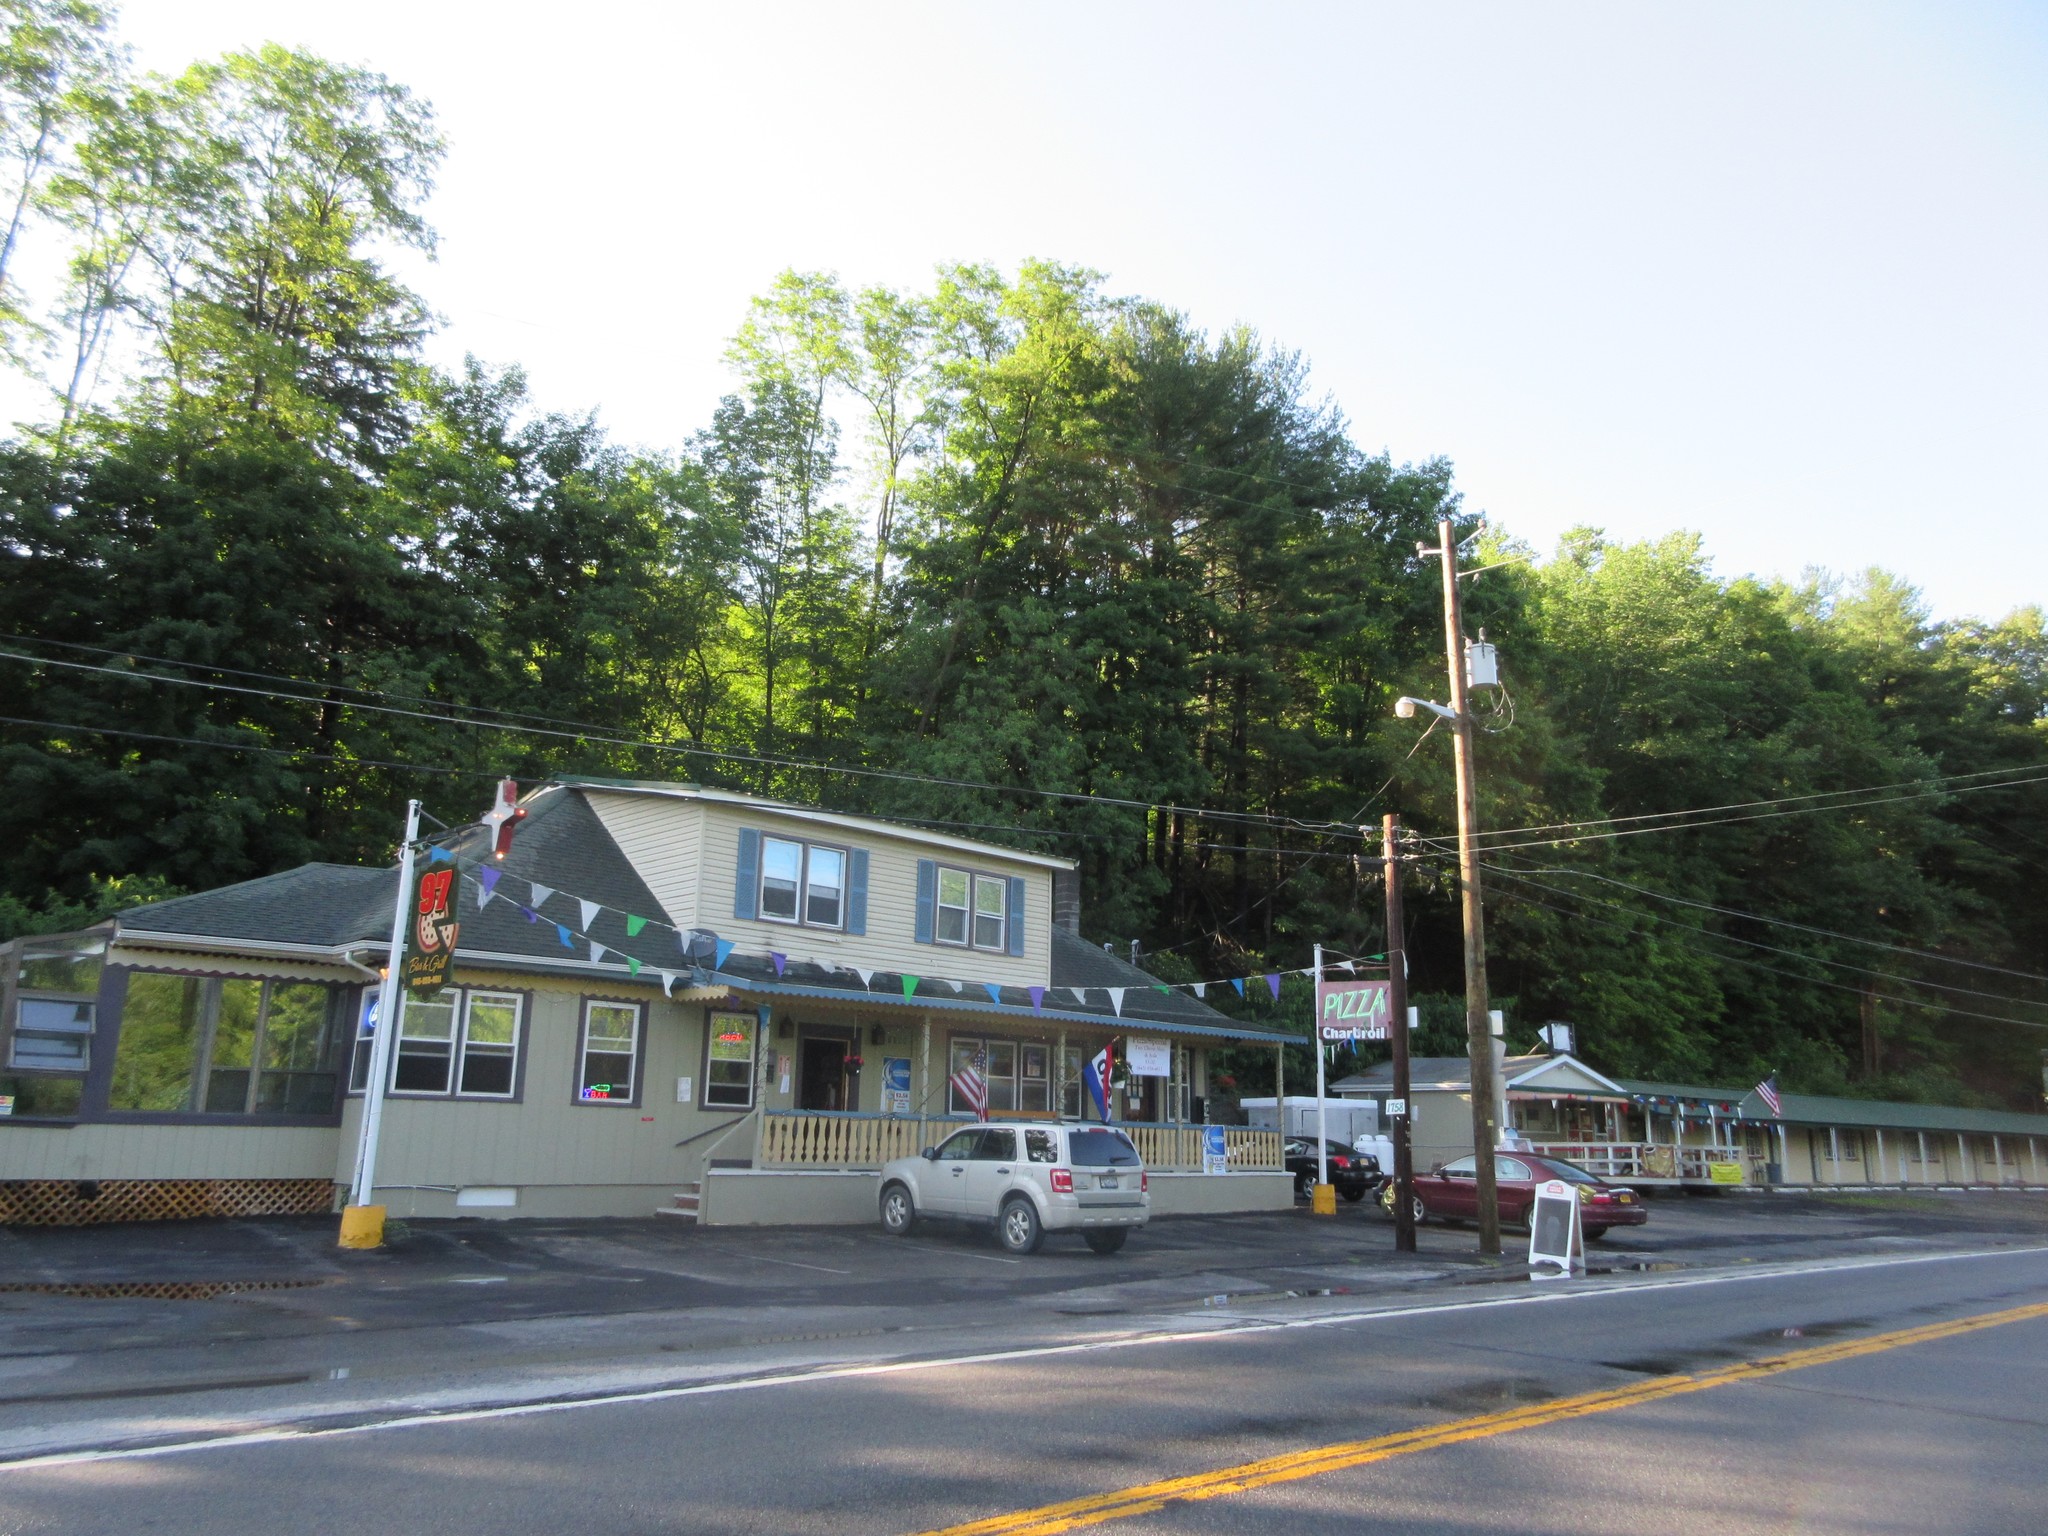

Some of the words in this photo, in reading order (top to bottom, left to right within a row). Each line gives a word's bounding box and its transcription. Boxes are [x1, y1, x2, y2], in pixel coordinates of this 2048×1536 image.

[419, 869, 453, 914] 97
[1324, 987, 1386, 1020] PIZZA
[1323, 1027, 1385, 1039] Charbroil
[590, 1090, 608, 1099] BAR
[1387, 1102, 1403, 1113] 1758
